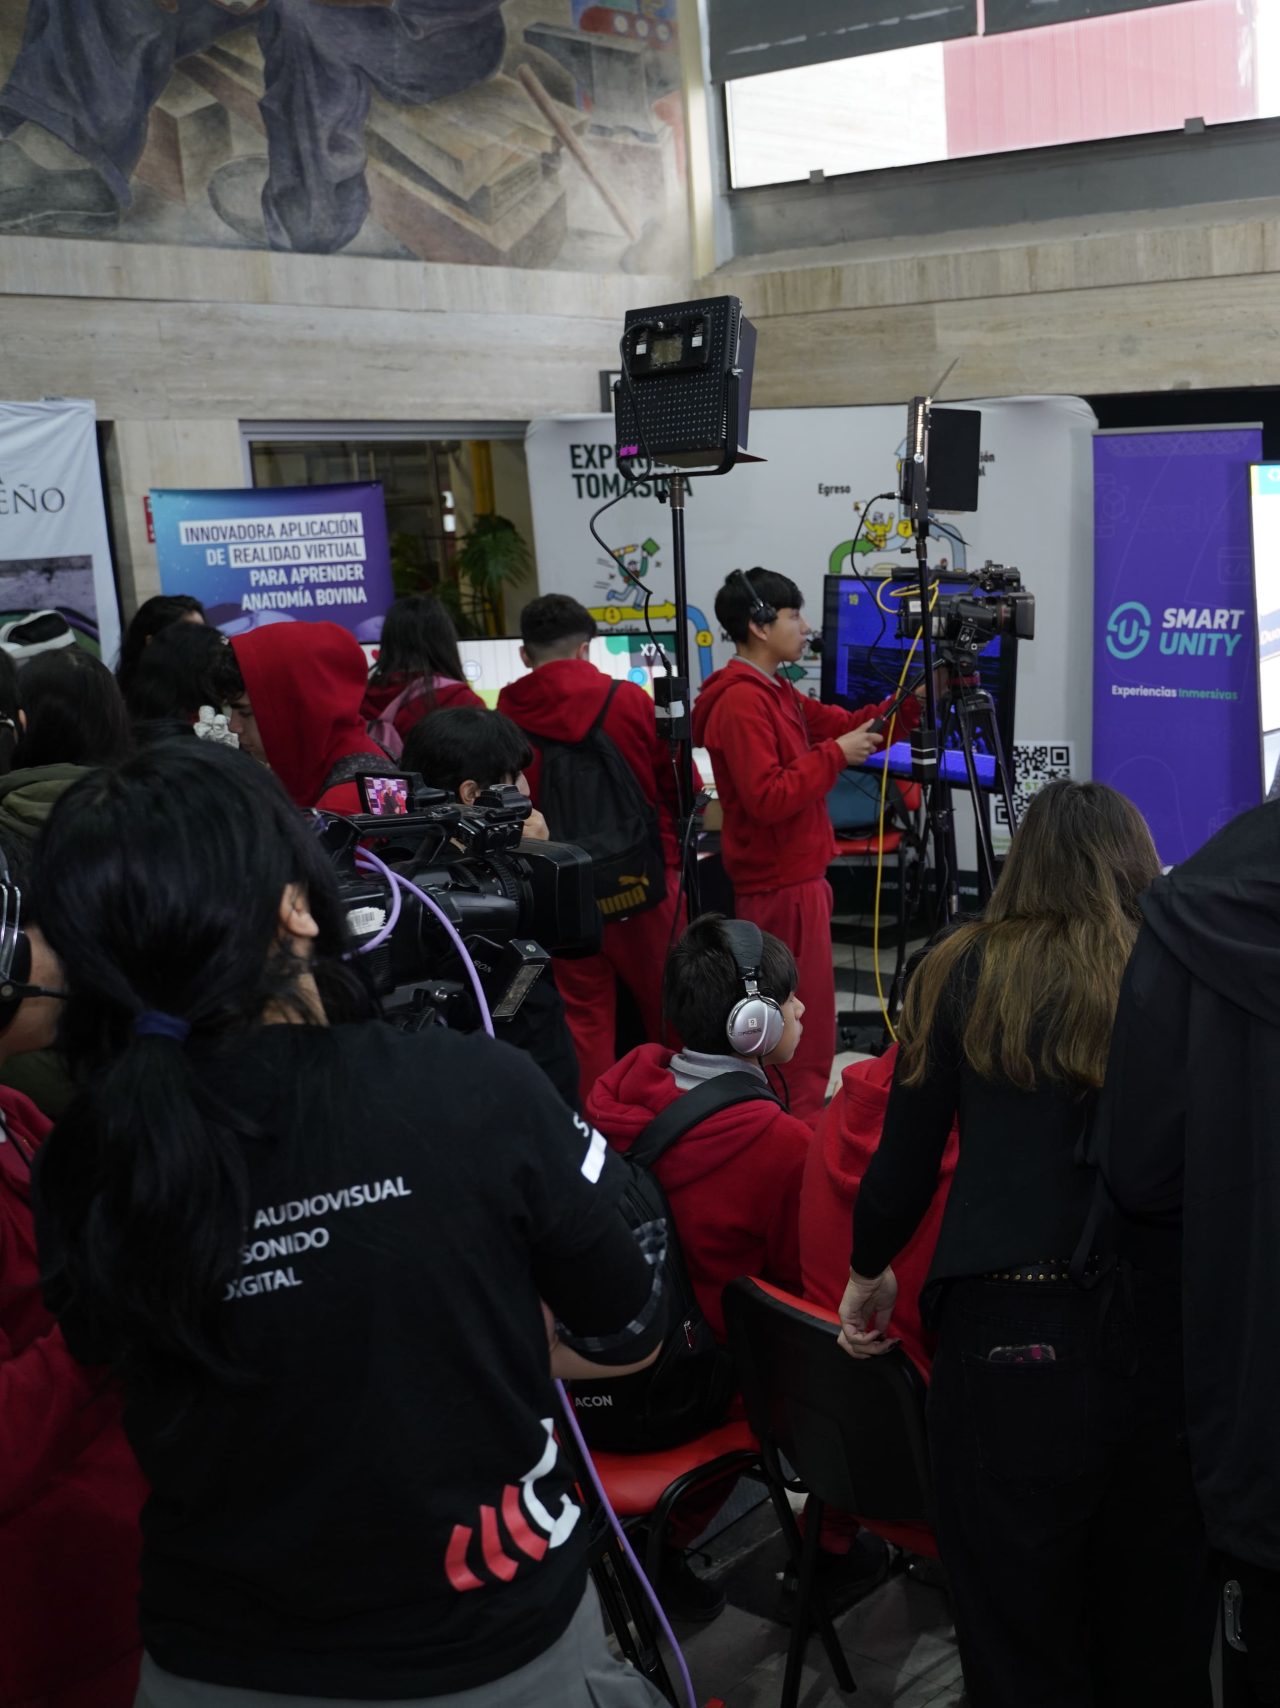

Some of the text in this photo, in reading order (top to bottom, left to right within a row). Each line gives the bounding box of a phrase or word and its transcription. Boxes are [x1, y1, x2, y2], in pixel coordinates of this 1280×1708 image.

[818, 483, 851, 496] Egreso
[185, 515, 359, 543] INNOVADORA APLICACIÓN
[206, 542, 362, 567] DE REALIDAD VIRTUAL
[250, 564, 364, 588] PARA APRENDER
[242, 586, 367, 611] ANATOMÍA BOVINA
[1162, 607, 1245, 630] SMART
[1159, 632, 1242, 656] UNITY
[1112, 685, 1238, 700] Experiencias Inmersivas
[253, 1177, 412, 1229] AUDIOVISUAL
